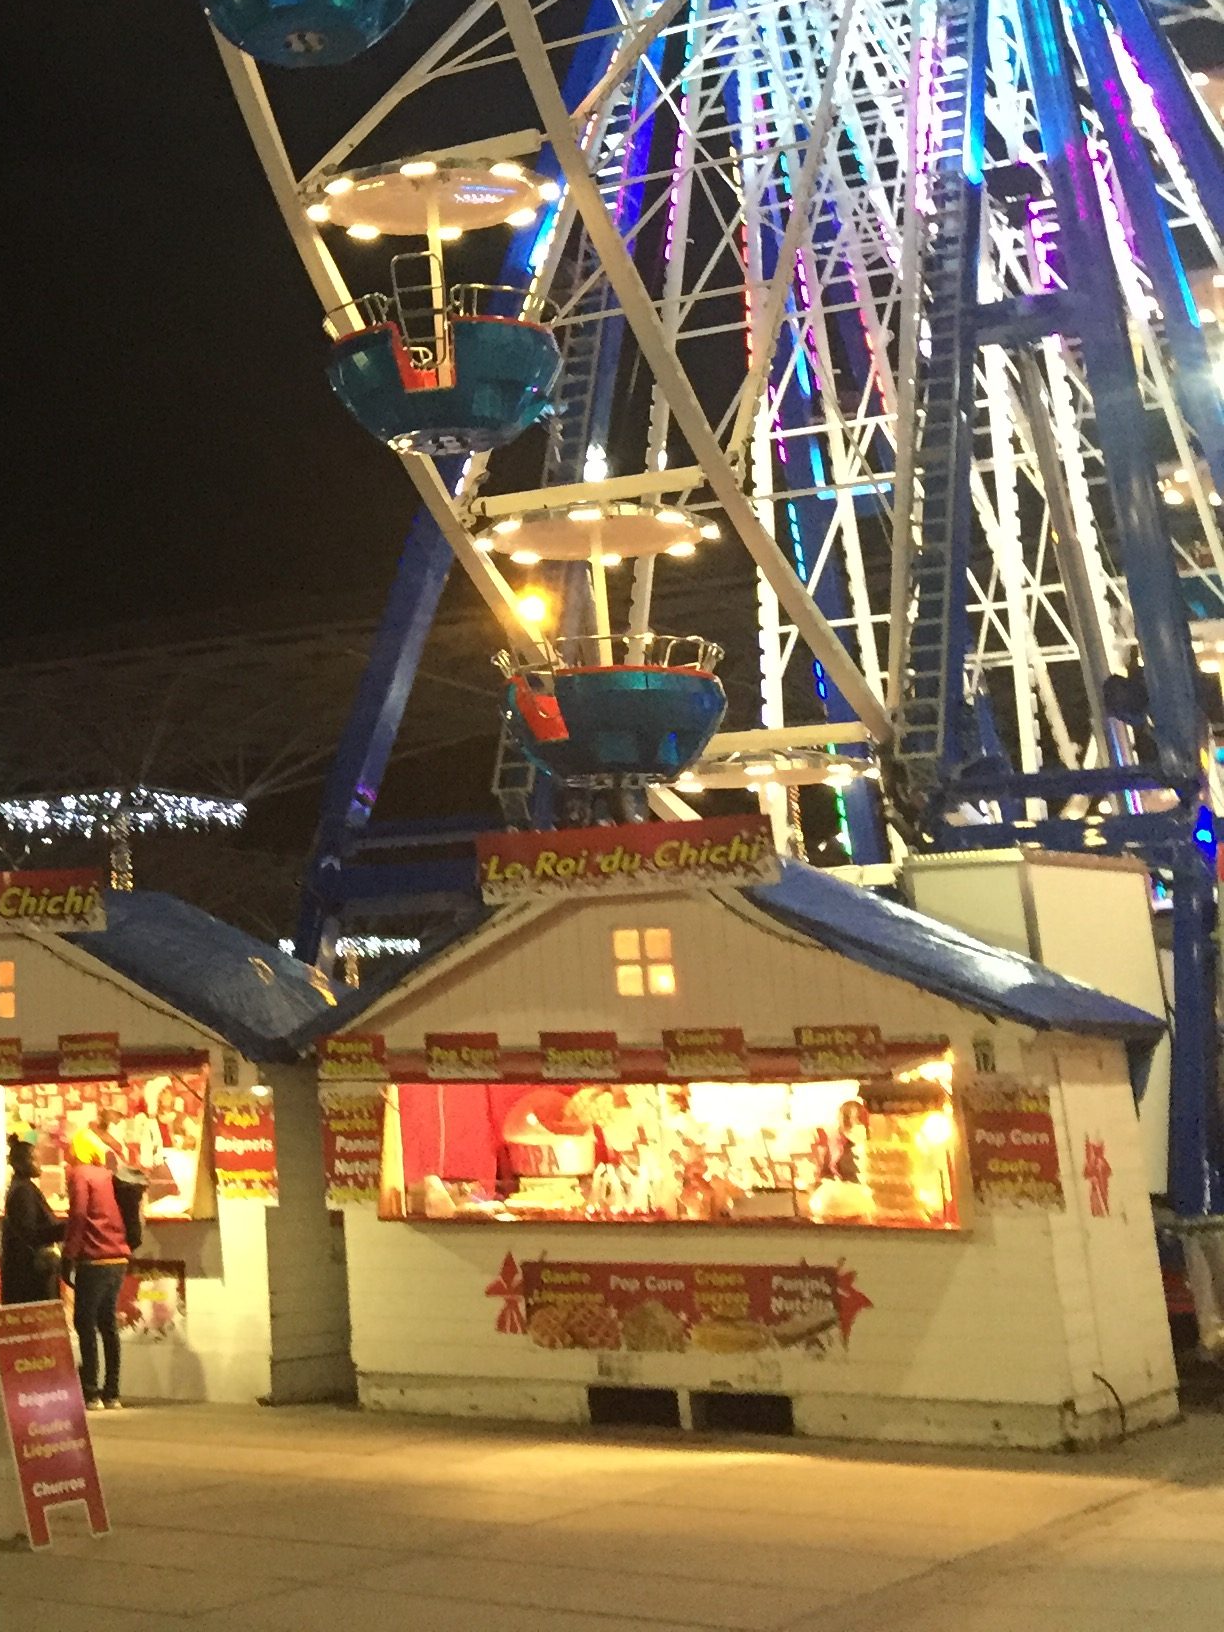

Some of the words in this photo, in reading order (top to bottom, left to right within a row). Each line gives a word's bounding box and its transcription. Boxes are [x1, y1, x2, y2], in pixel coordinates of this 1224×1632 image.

[486, 855, 523, 881] Le
[535, 849, 588, 877] Roi
[599, 845, 642, 874] du
[654, 832, 765, 869] Chichi
[214, 1135, 275, 1156] Beignets
[1010, 1128, 1050, 1146] Corn
[609, 1274, 641, 1294] Pop
[644, 1275, 686, 1293] Corn
[18, 1388, 69, 1408] Beignets
[32, 1476, 87, 1498] Churros
